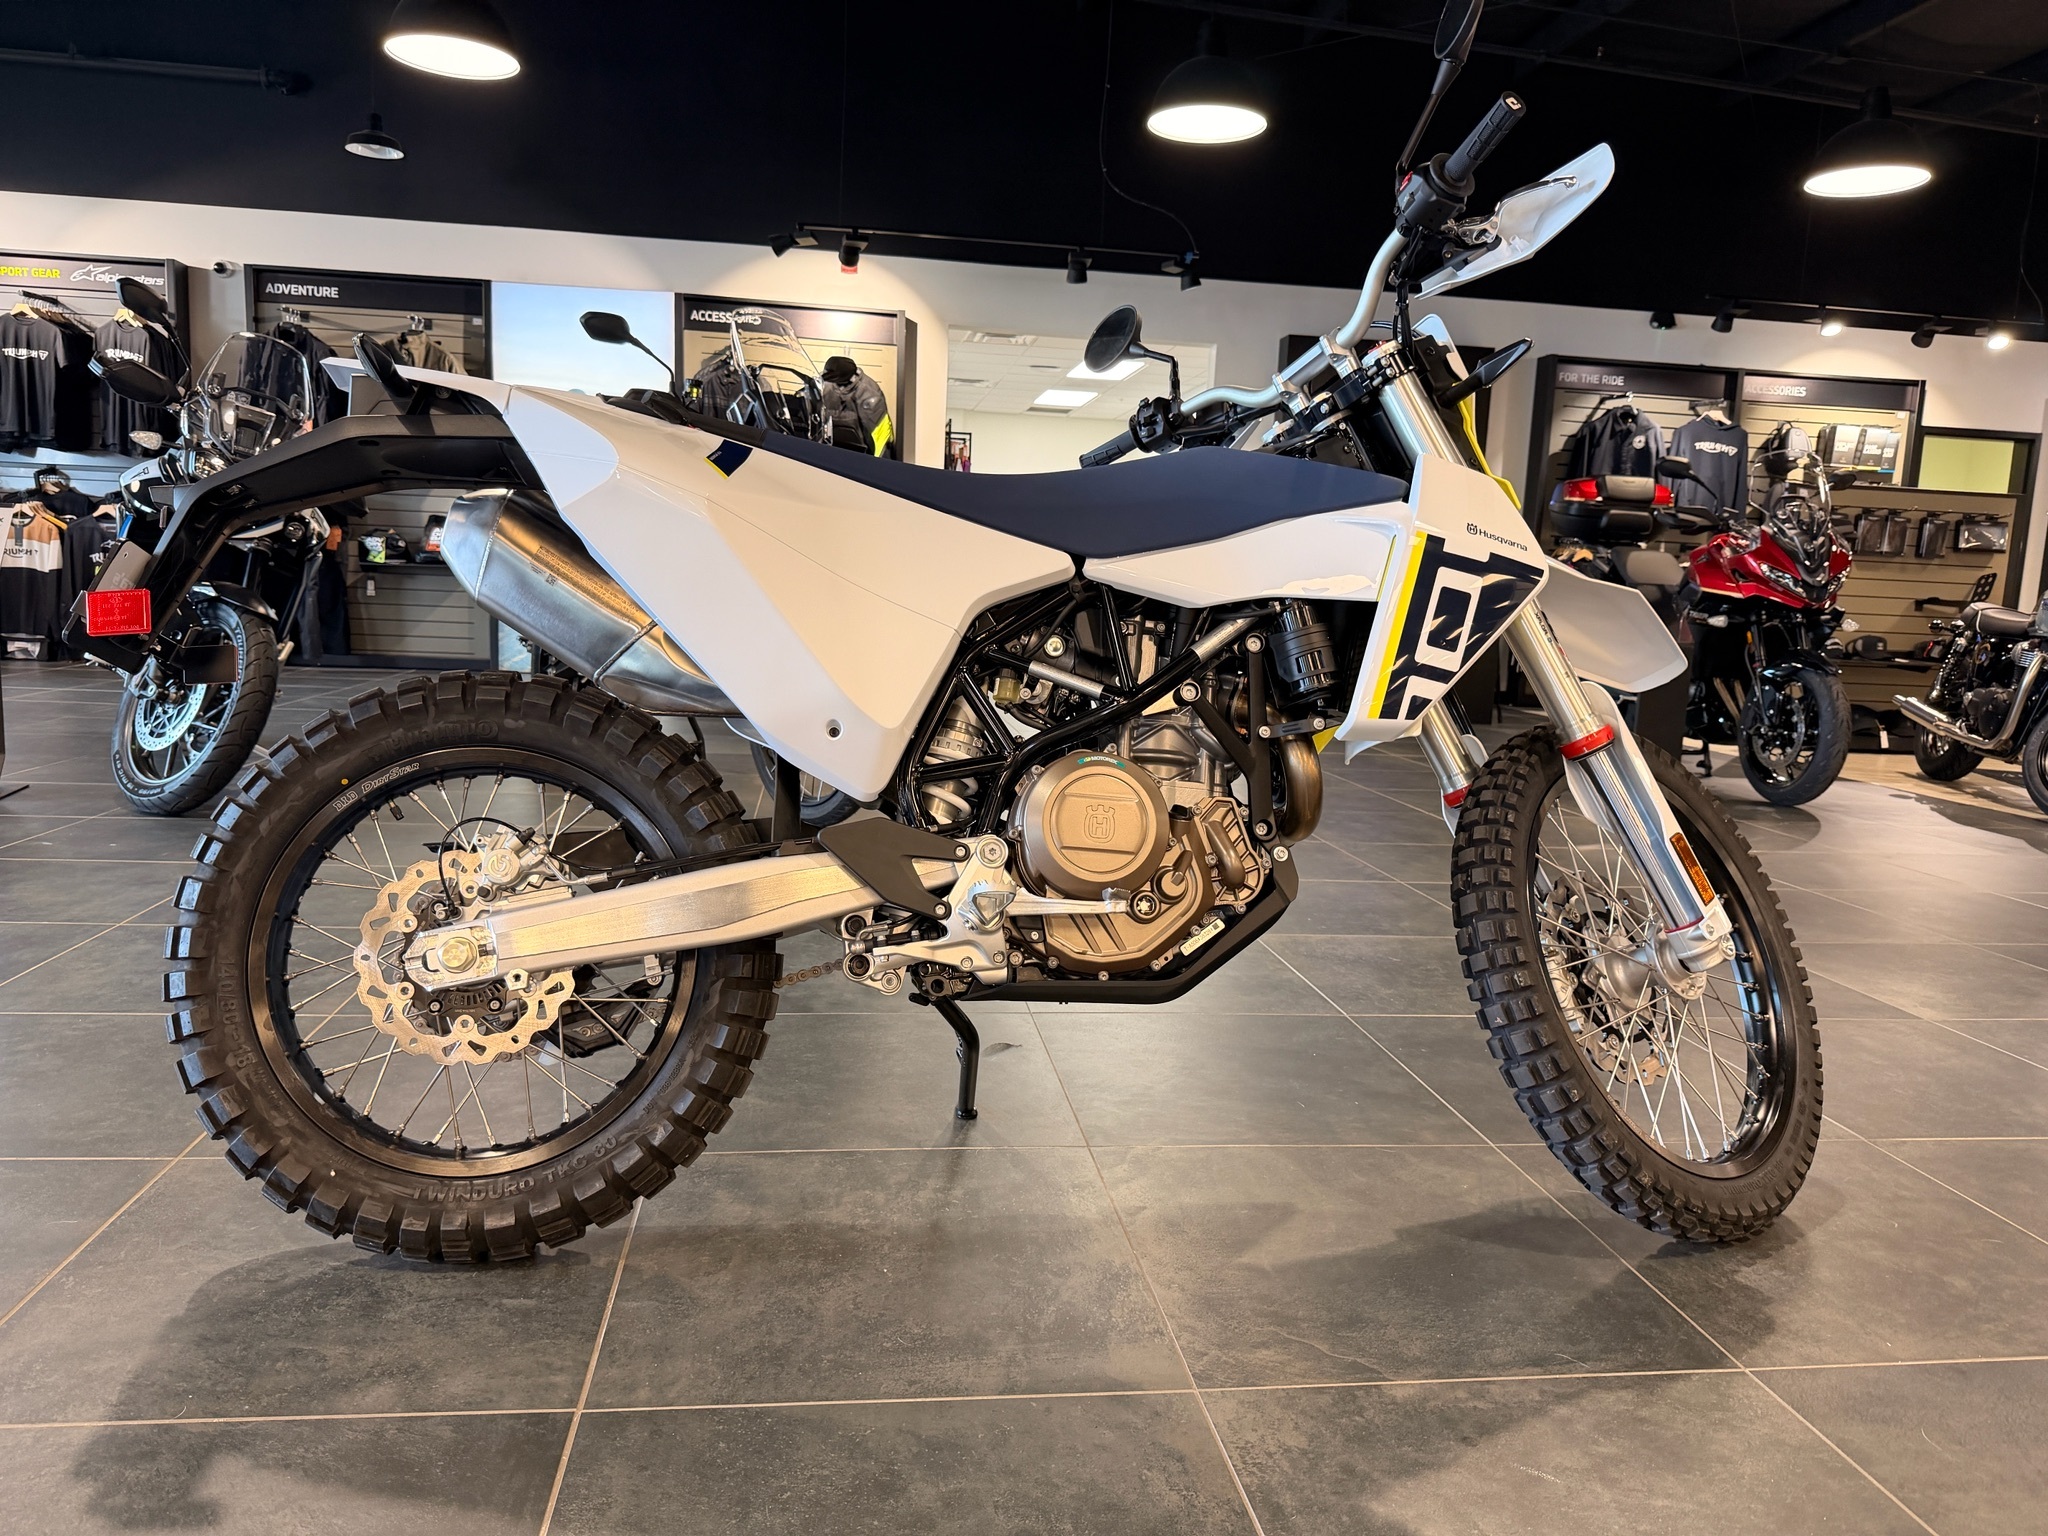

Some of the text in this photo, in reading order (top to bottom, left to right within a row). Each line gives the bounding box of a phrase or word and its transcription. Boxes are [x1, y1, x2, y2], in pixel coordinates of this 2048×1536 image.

[0, 266, 60, 278] PORT GEAR
[95, 273, 164, 286] alpistars
[266, 283, 339, 299] ADVENTURE
[1559, 372, 1625, 386] FOR THE RIDE
[1744, 384, 1807, 397] ACCESSORIES
[1479, 528, 1528, 551] Husqvarna
[3, 547, 33, 559] RIUMPH
[1091, 755, 1119, 765] MOTOREX
[413, 1135, 618, 1202] TWINDURO TKC 80
